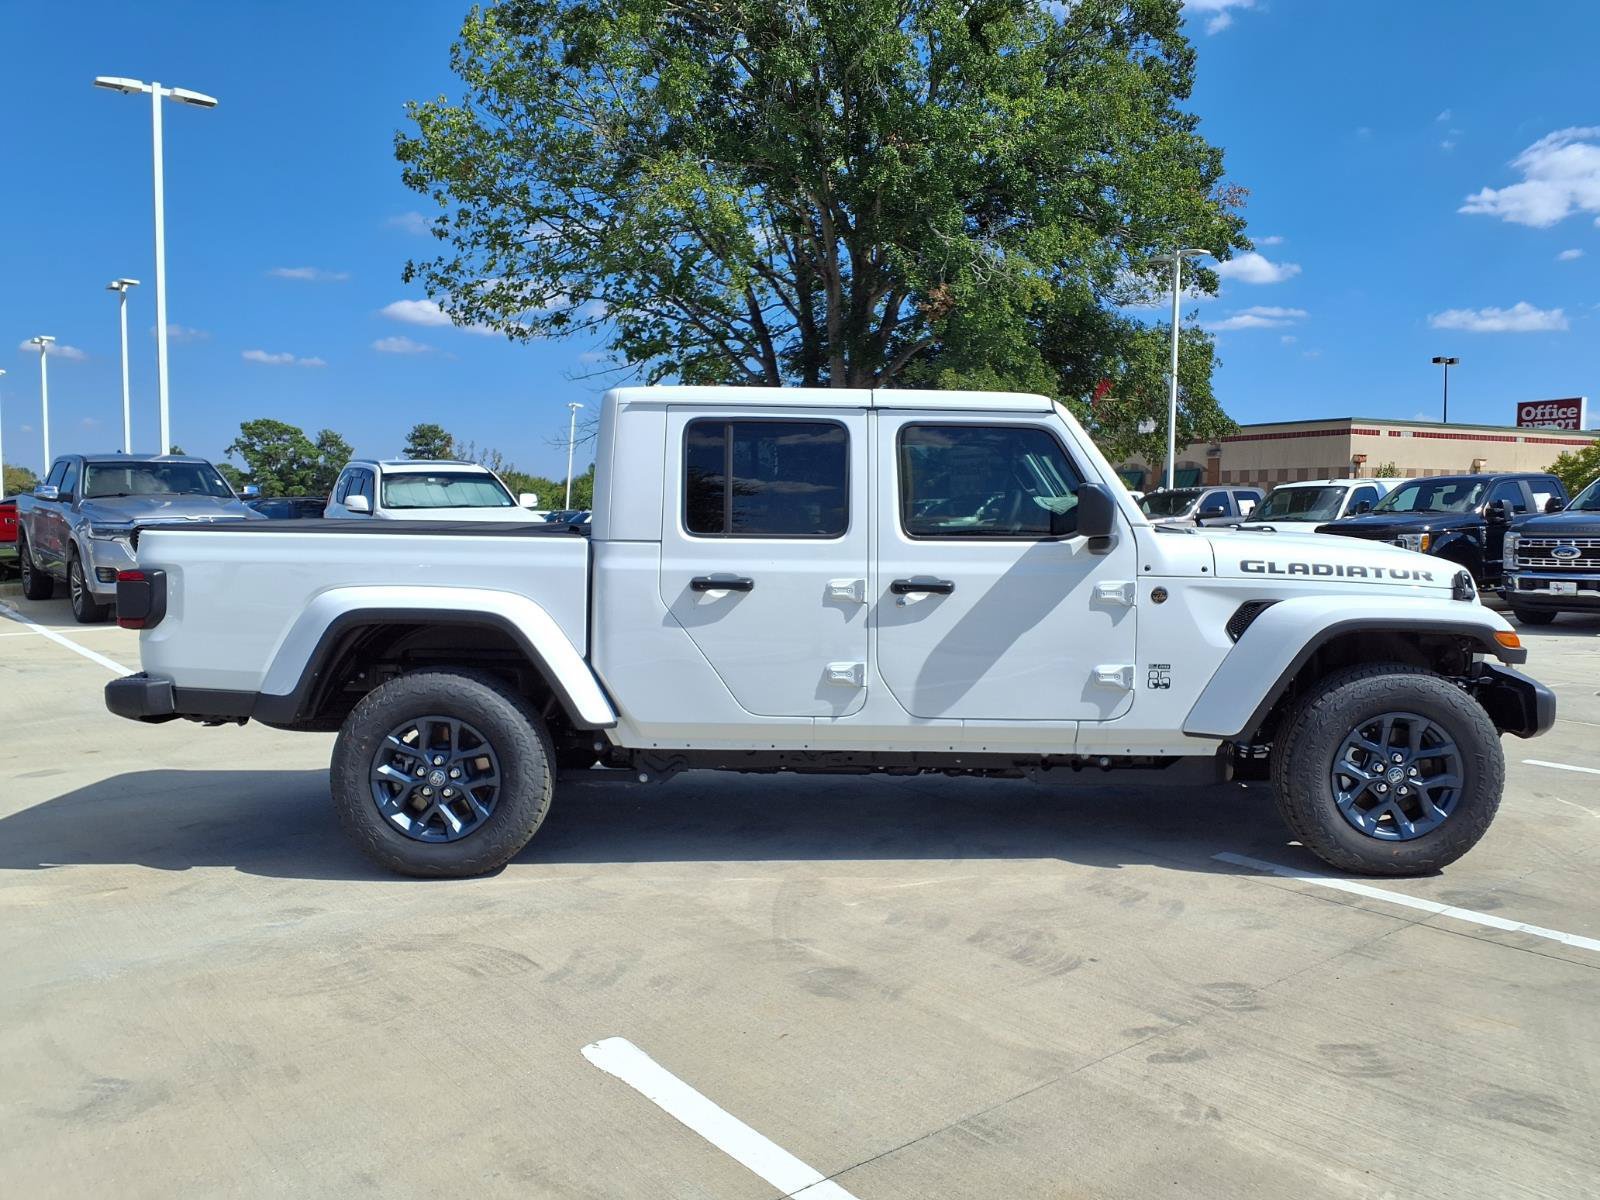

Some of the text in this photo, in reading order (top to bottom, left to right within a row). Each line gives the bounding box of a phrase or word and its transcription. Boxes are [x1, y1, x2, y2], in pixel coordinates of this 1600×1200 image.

[1521, 405, 1578, 421] Office
[1239, 559, 1434, 582] GLADIATOR
[1147, 670, 1171, 689] 85
